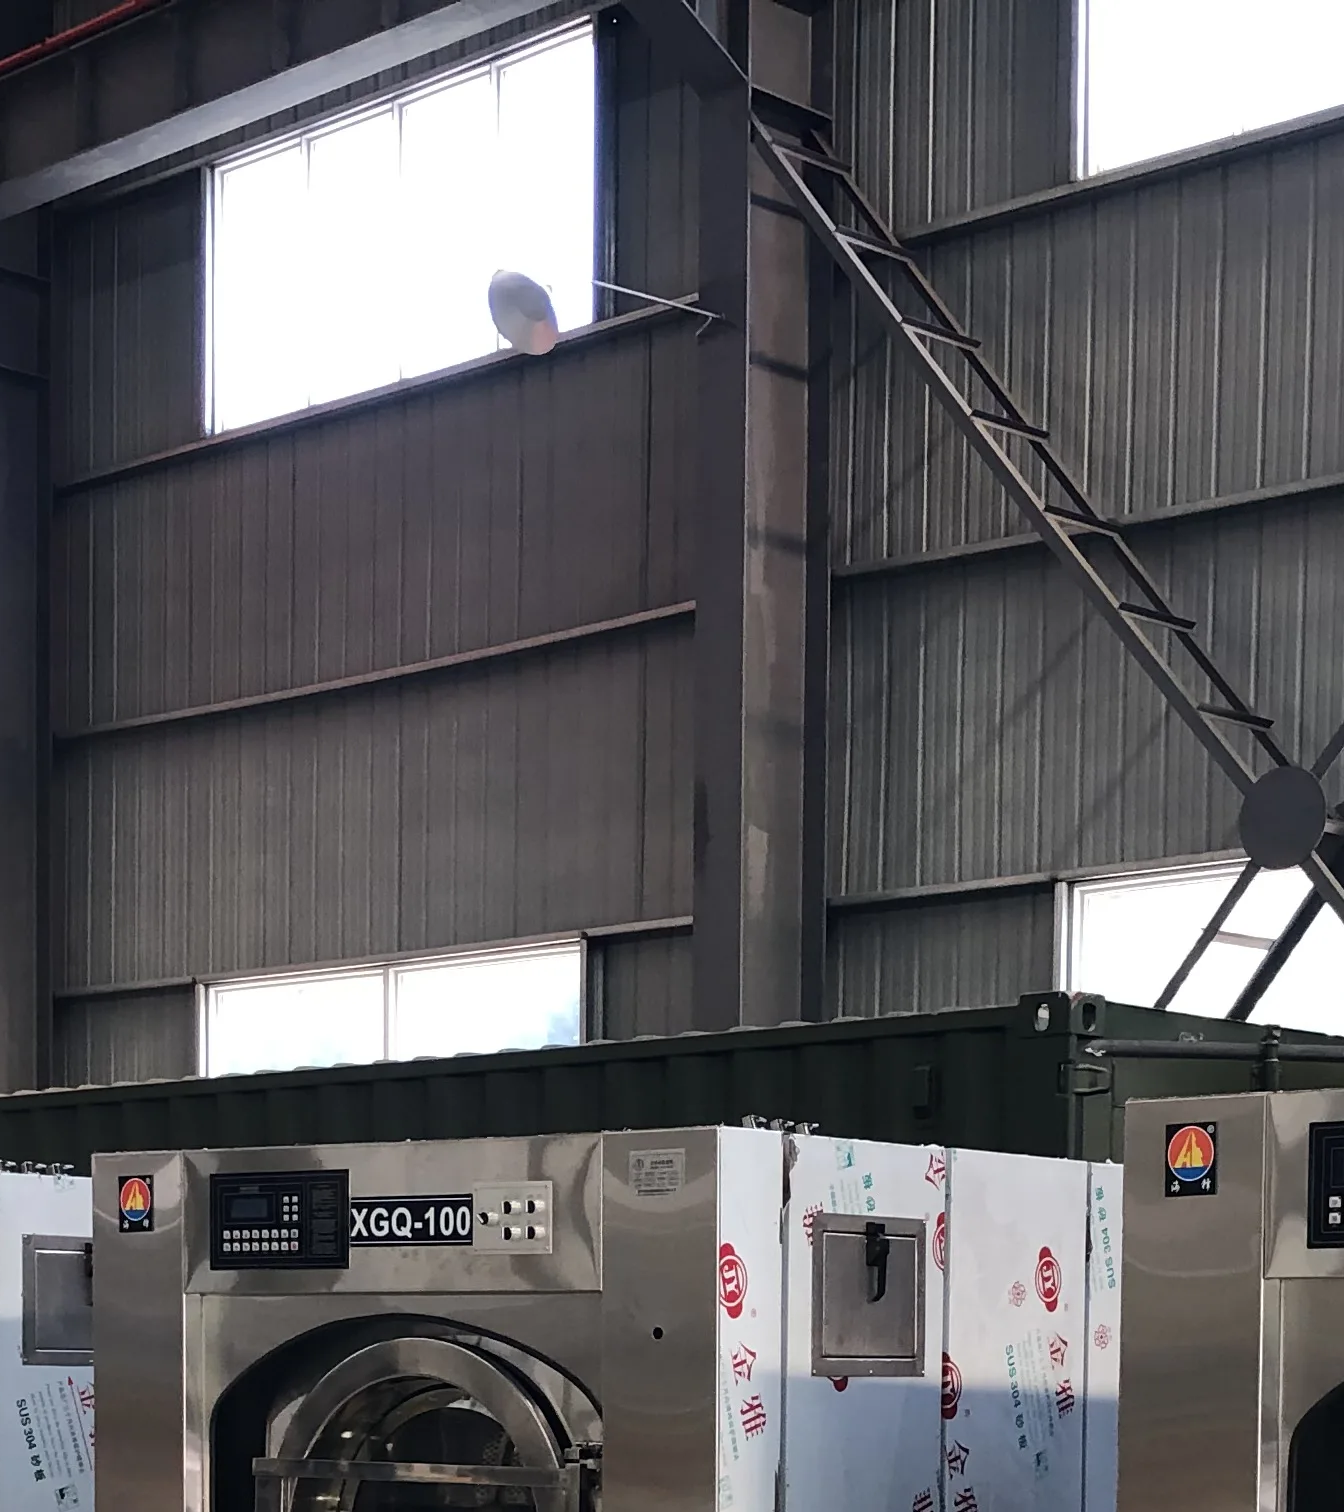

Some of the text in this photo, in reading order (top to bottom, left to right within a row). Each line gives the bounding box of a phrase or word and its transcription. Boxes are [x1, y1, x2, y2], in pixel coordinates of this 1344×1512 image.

[350, 1206, 471, 1239] XGQ-100
[1101, 1227, 1112, 1256] 304
[1105, 1256, 1117, 1289] SUS
[1006, 1344, 1017, 1379] SUS
[730, 1341, 766, 1441] 金雅
[1010, 1380, 1022, 1409] 304
[16, 1399, 31, 1427] SUS
[22, 1427, 37, 1451] 304
